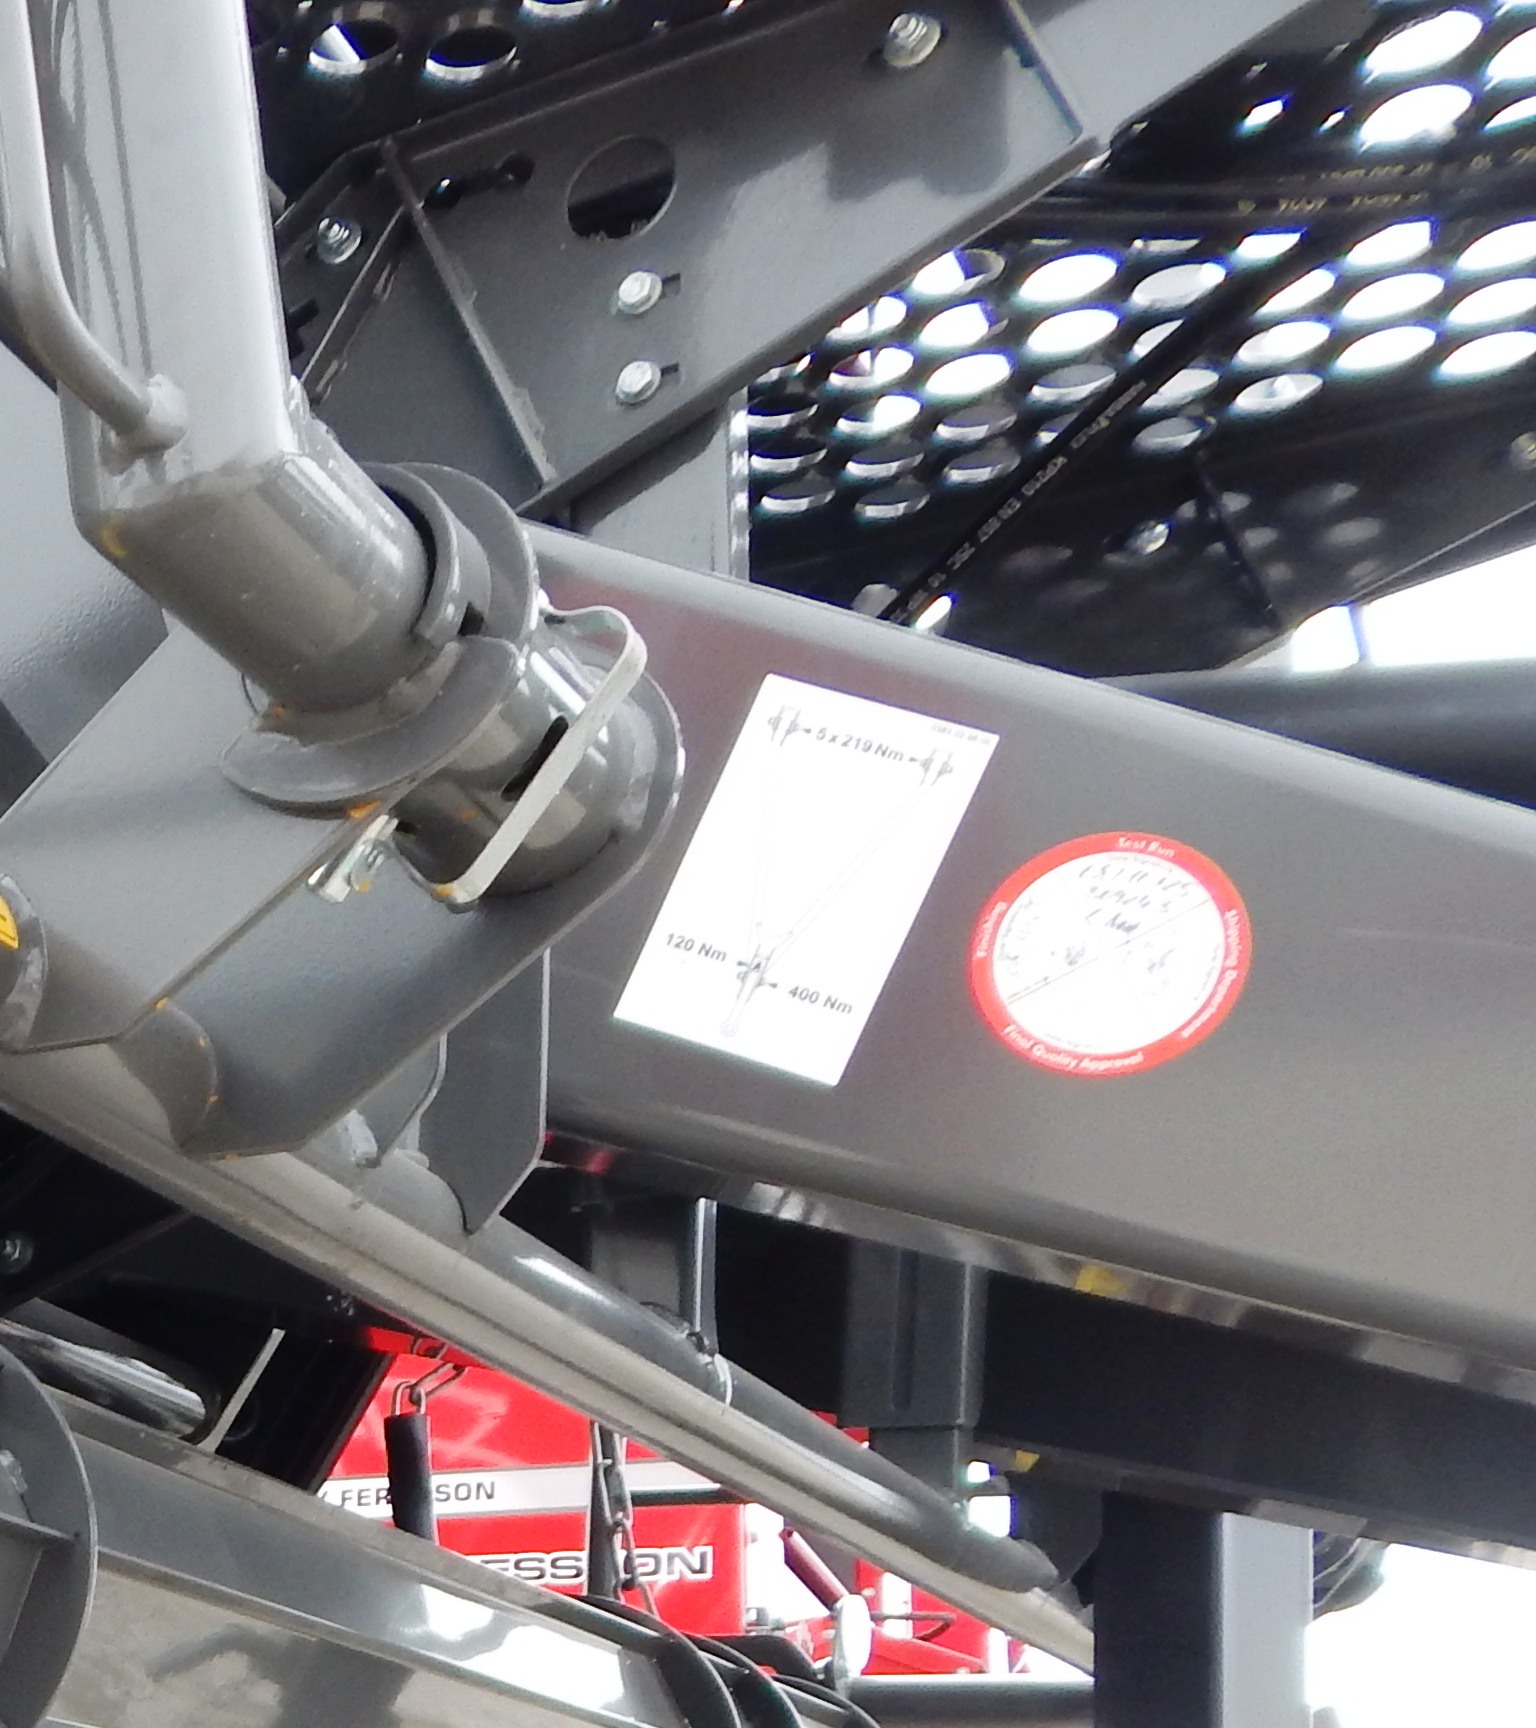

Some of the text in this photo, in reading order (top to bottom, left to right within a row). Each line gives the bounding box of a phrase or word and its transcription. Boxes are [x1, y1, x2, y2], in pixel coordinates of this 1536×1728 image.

[815, 727, 828, 742] 5
[840, 735, 873, 754] 219
[874, 745, 904, 762] Nm
[1148, 840, 1175, 858] Run
[665, 932, 727, 962] 120 Nm
[788, 985, 853, 1014] 400 Nm
[1002, 1024, 1034, 1049] Final
[1031, 1043, 1079, 1070] Quality
[1078, 1051, 1145, 1071] Approval
[341, 1481, 496, 1508] FERSON
[478, 1550, 709, 1581] ESSON
